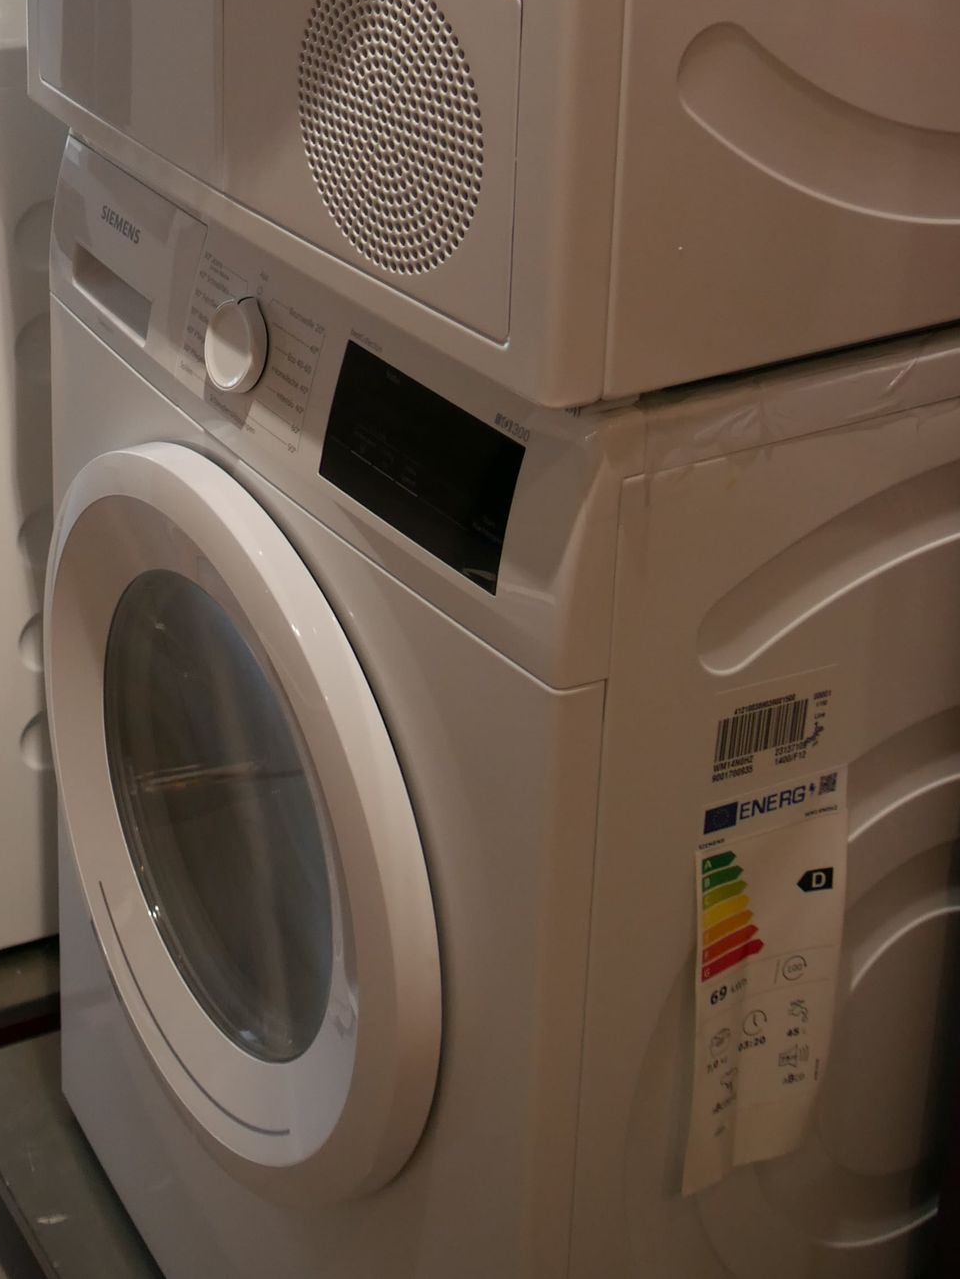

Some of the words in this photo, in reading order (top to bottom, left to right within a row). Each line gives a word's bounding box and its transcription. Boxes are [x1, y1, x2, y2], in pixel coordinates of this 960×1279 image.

[101, 205, 141, 244] SIEMENS
[704, 860, 712, 870] A
[811, 872, 826, 888] D
[710, 984, 728, 1006] 69
